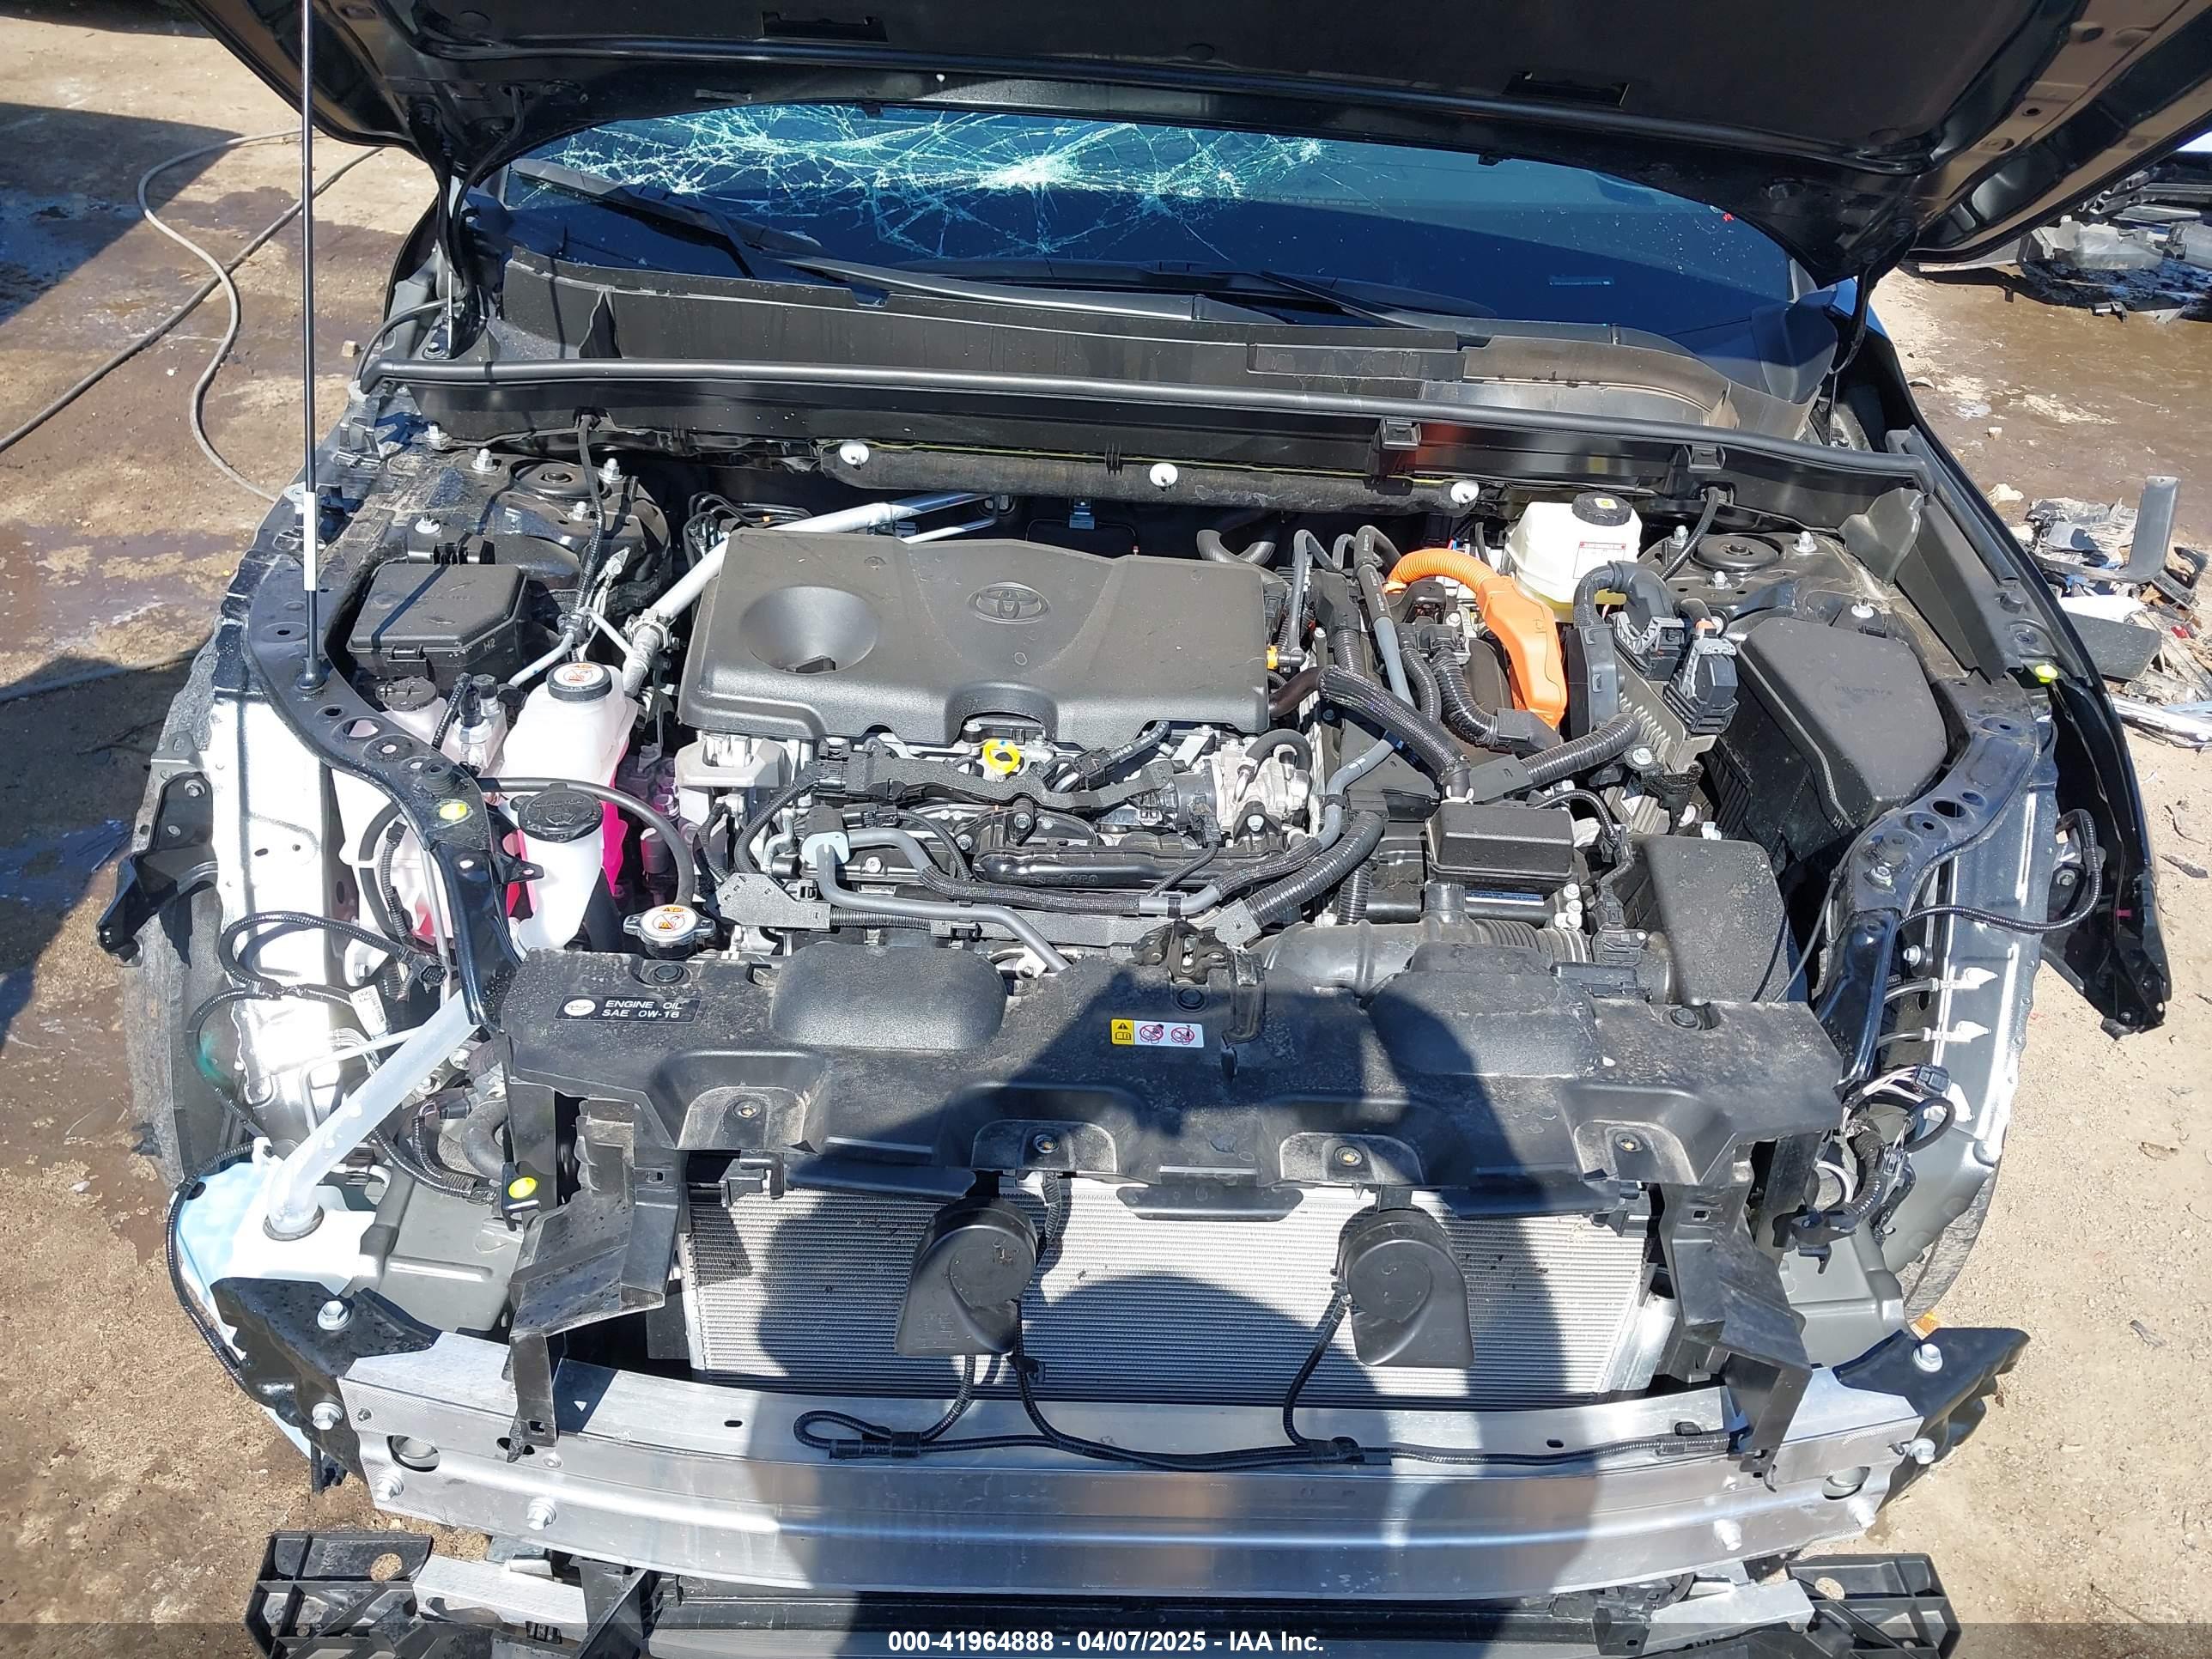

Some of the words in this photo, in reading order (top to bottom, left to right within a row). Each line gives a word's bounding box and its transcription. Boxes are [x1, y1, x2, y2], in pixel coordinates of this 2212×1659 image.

[483, 638, 496, 652] H2
[605, 1000, 654, 1009] ENGINE
[601, 1009, 630, 1018] SAE
